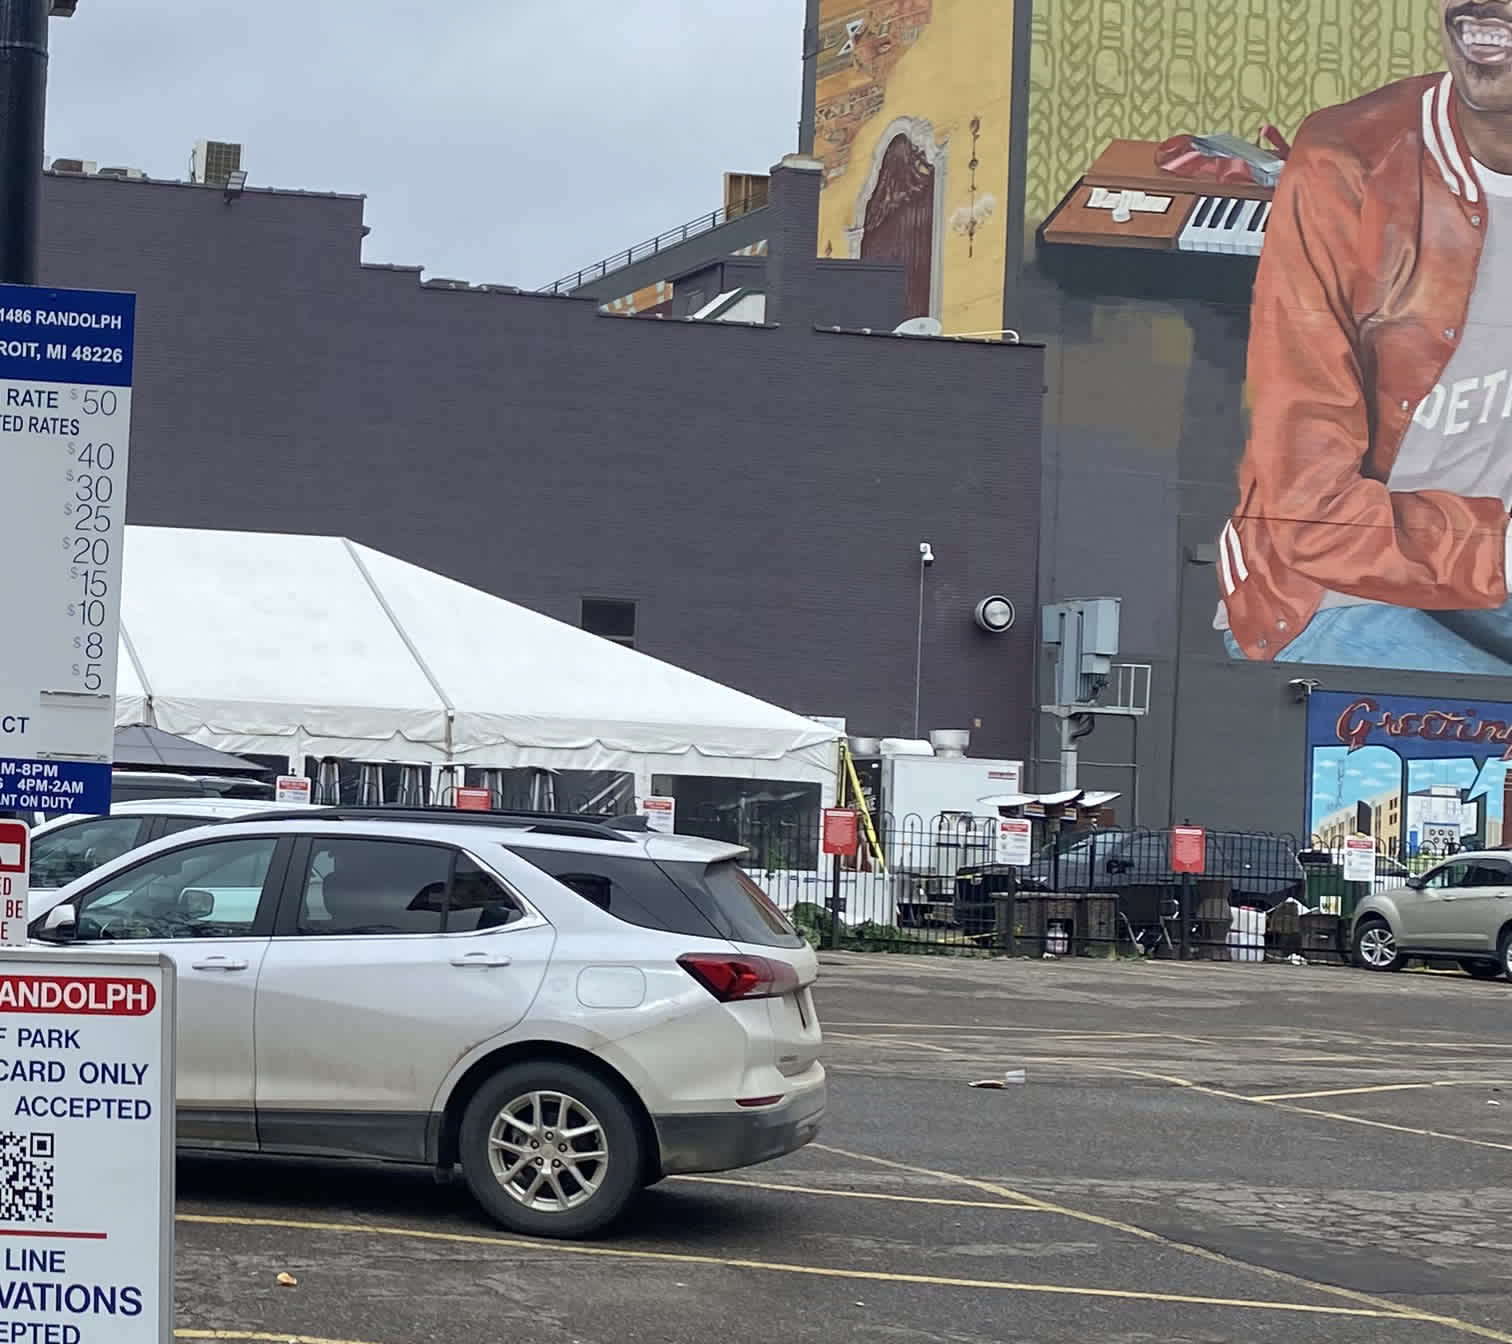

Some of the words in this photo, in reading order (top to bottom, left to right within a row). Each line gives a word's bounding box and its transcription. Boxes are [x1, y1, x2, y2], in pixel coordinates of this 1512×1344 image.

[36, 310, 122, 330] RANDOLPH
[46, 344, 67, 360] MI
[71, 345, 123, 364] 48226
[7, 388, 59, 409] RATE
[28, 417, 80, 436] RATES
[17, 778, 84, 794] 4PM-2AM
[19, 795, 38, 808] ON
[40, 796, 74, 809] DUTY
[5, 899, 24, 919] BE
[17, 1028, 81, 1049] PARK
[79, 1062, 149, 1086] ONLY
[14, 1095, 152, 1121] ACCEPTED
[6, 1248, 66, 1273] LINE
